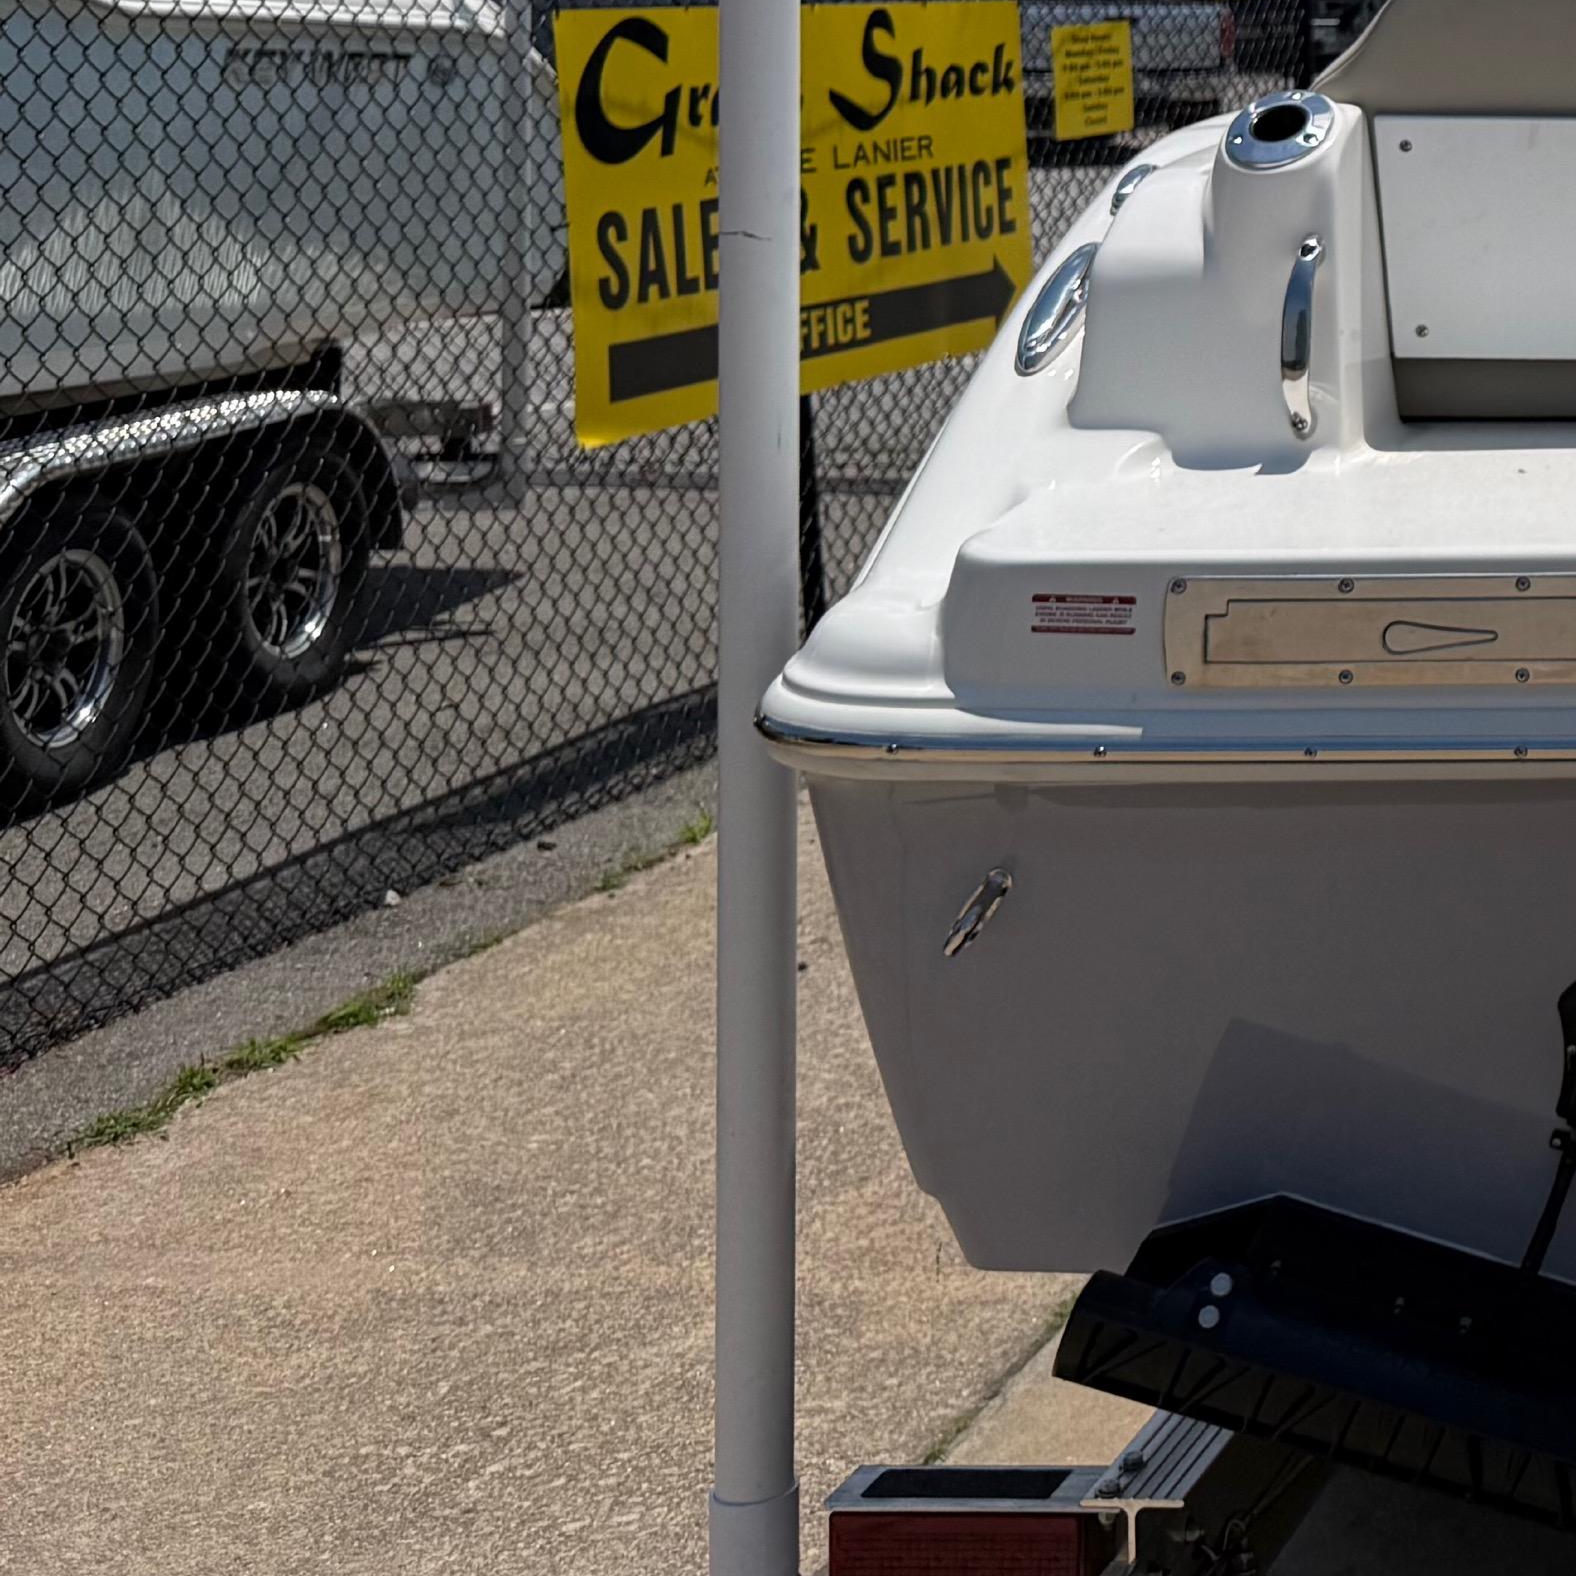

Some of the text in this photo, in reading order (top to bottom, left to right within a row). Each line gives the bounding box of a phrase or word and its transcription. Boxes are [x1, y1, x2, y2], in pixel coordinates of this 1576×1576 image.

[828, 8, 1015, 131] Shack
[833, 135, 933, 170] LANIER
[597, 198, 719, 310] SALE
[846, 157, 1016, 264] SERVICE
[800, 298, 872, 351] FFICE
